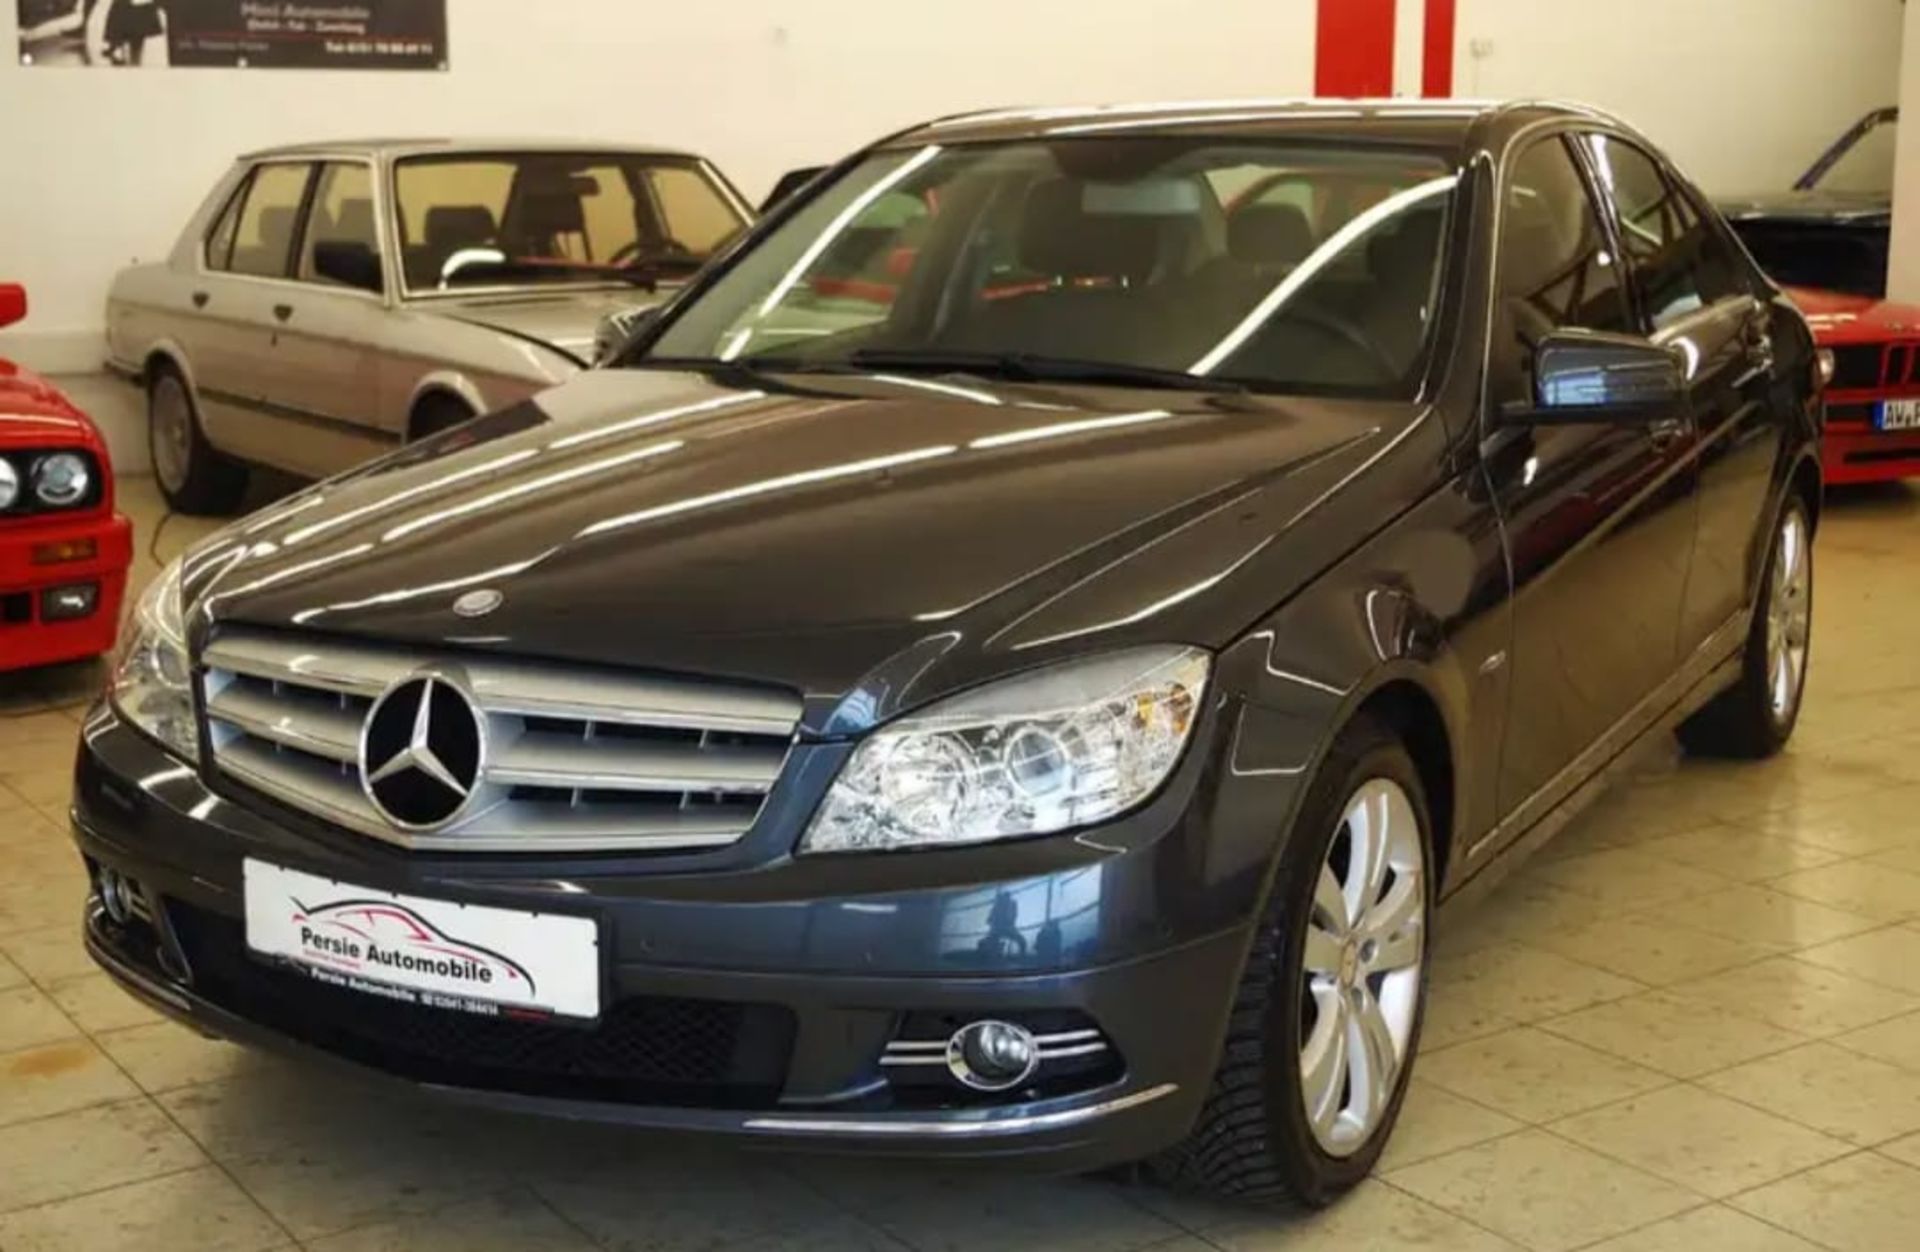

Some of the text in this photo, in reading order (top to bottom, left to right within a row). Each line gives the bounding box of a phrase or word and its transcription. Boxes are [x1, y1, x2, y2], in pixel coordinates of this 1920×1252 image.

[301, 926, 361, 959] Persie
[366, 944, 493, 983] Automobile
[310, 967, 346, 986] Persie
[349, 977, 416, 1002] Automobile
